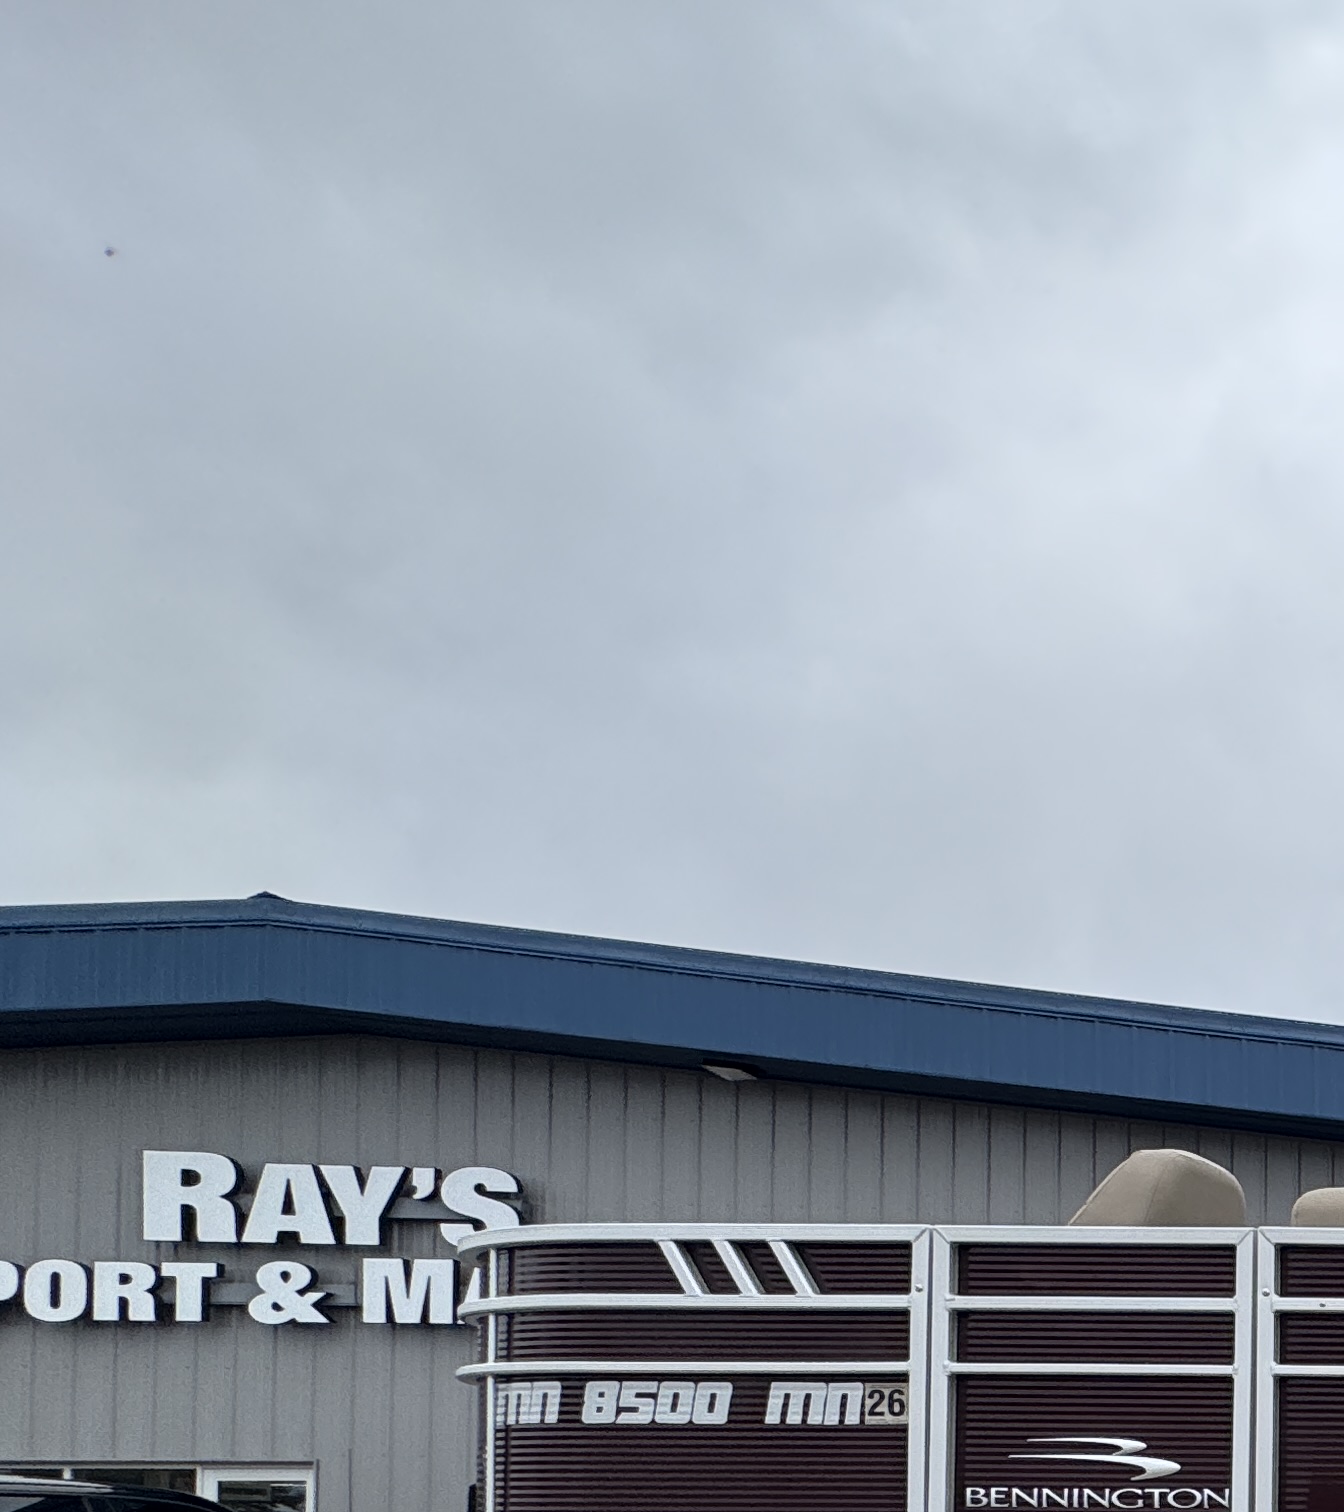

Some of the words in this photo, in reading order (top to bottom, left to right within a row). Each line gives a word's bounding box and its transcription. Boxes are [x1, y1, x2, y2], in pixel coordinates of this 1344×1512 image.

[142, 1149, 520, 1247] RAY'S
[248, 1260, 330, 1325] &
[362, 1257, 481, 1325] M
[580, 1381, 733, 1425] 8500
[765, 1382, 864, 1425] MN
[867, 1389, 906, 1417] 26
[964, 1486, 1231, 1509] BENNINGTON
